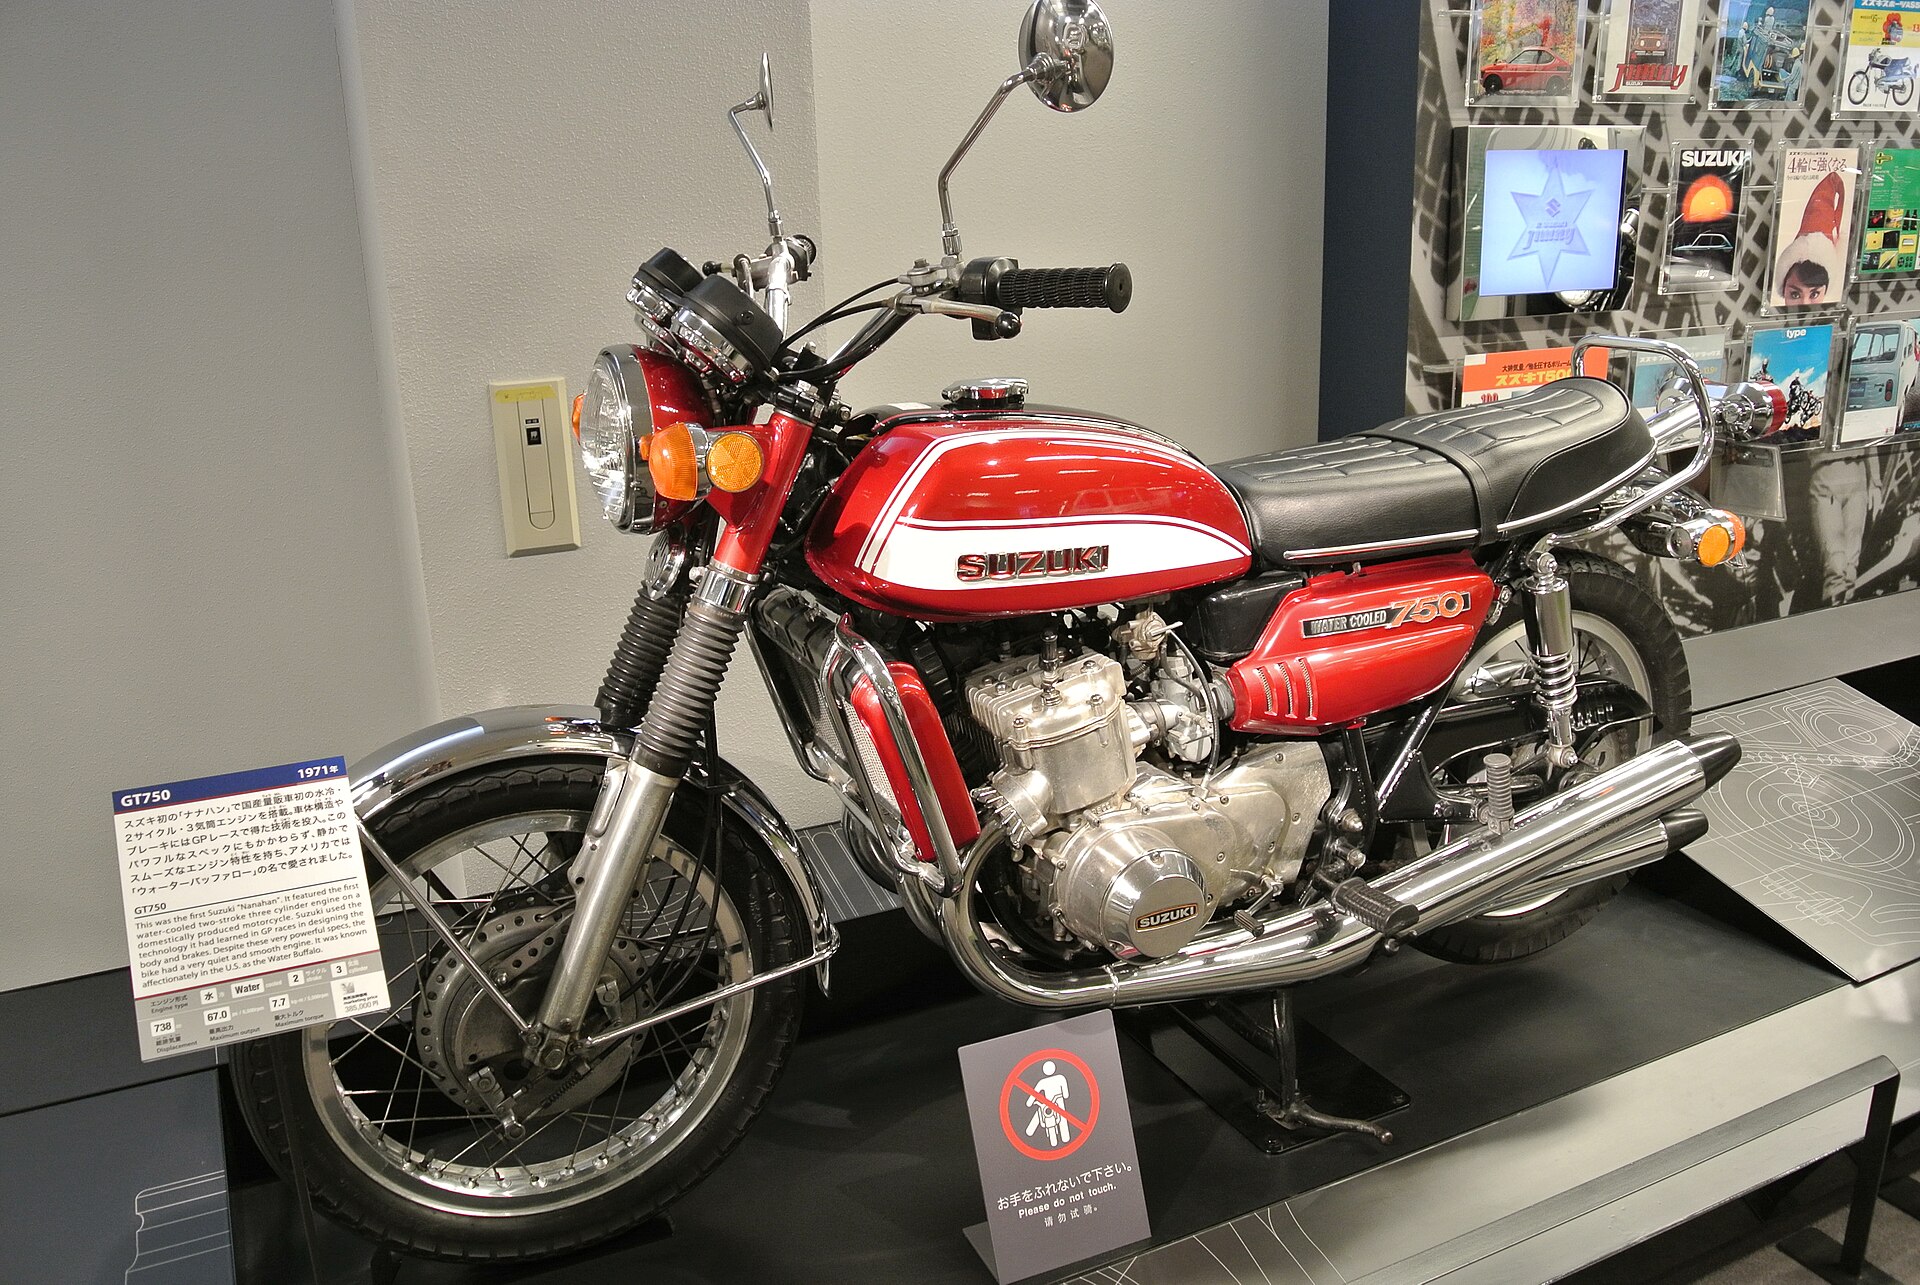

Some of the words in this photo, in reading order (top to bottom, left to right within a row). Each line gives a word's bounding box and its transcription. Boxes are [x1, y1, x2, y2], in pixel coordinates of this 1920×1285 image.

[1681, 150, 1745, 167] SUZUKI
[1788, 157, 1847, 173] 4輪に強くなる
[1786, 329, 1807, 339] type
[956, 545, 1109, 582] SUZUKI
[1310, 618, 1347, 635] WATER
[1350, 610, 1387, 628] COOLED
[1385, 591, 1465, 629] 750
[297, 764, 338, 778] 1971年
[120, 789, 170, 806] GT750
[133, 902, 166, 914] GT750
[134, 920, 153, 930] This
[154, 918, 172, 926] was
[172, 914, 188, 923] the
[188, 910, 206, 920] first
[207, 904, 235, 916] Suzuki
[291, 887, 327, 900] featured
[327, 886, 342, 894] the
[342, 882, 359, 891] first
[135, 921, 196, 939] water-cooled
[197, 913, 246, 928] two-stroke
[247, 908, 271, 918] three
[272, 901, 308, 914] cylinder
[310, 896, 340, 906] engine
[341, 893, 353, 901] on
[1139, 906, 1194, 928] SUZUKI
[136, 932, 195, 949] domestically
[196, 922, 240, 939] produced
[241, 914, 293, 929] motorcycle.
[294, 907, 323, 919] Suzuki
[324, 902, 346, 913] used
[347, 901, 362, 909] the
[138, 944, 188, 959] technology
[189, 941, 196, 949] it
[197, 937, 215, 947] had
[216, 930, 249, 943] learned
[260, 926, 272, 935] GP
[274, 923, 296, 932] races
[297, 920, 306, 928] in
[307, 913, 348, 926] designing
[349, 910, 364, 918] the
[139, 958, 162, 968] body
[163, 954, 180, 964] and
[180, 949, 212, 960] brakes.
[212, 942, 244, 954] Despite
[245, 938, 268, 948] these
[269, 934, 288, 943] very
[288, 925, 325, 940] powerful
[326, 922, 351, 932] specs,
[351, 919, 366, 927] the
[140, 969, 160, 978] bike
[160, 964, 178, 974] had
[186, 960, 205, 969] very
[206, 955, 230, 966] quiet
[230, 950, 247, 960] and
[248, 944, 281, 957] smooth
[282, 939, 313, 950] engine.
[314, 936, 321, 944] It
[321, 934, 338, 942] was
[339, 928, 367, 939] known
[141, 970, 198, 988] affectionately
[209, 966, 224, 974] the
[224, 962, 241, 972] U.S.
[251, 958, 266, 966] the
[266, 952, 291, 963] Water
[292, 946, 323, 958] Buffalo.
[335, 965, 342, 974] 3
[292, 973, 299, 983] 2
[203, 990, 214, 1001] 水
[234, 981, 260, 995] Water
[271, 997, 286, 1008] 7.7
[206, 1009, 227, 1022] 67.0
[274, 1018, 303, 1028] Maximum
[304, 1013, 324, 1022] torque
[154, 1021, 172, 1033] 738
[209, 1031, 239, 1042] Maximum
[239, 1026, 261, 1036] output
[156, 1039, 197, 1053] Displacement
[997, 1162, 1132, 1211] お手をふれないで下さい。
[1018, 1204, 1050, 1219] Please
[1053, 1198, 1065, 1208] do
[1069, 1191, 1085, 1203] not
[1089, 1182, 1117, 1197] touch.
